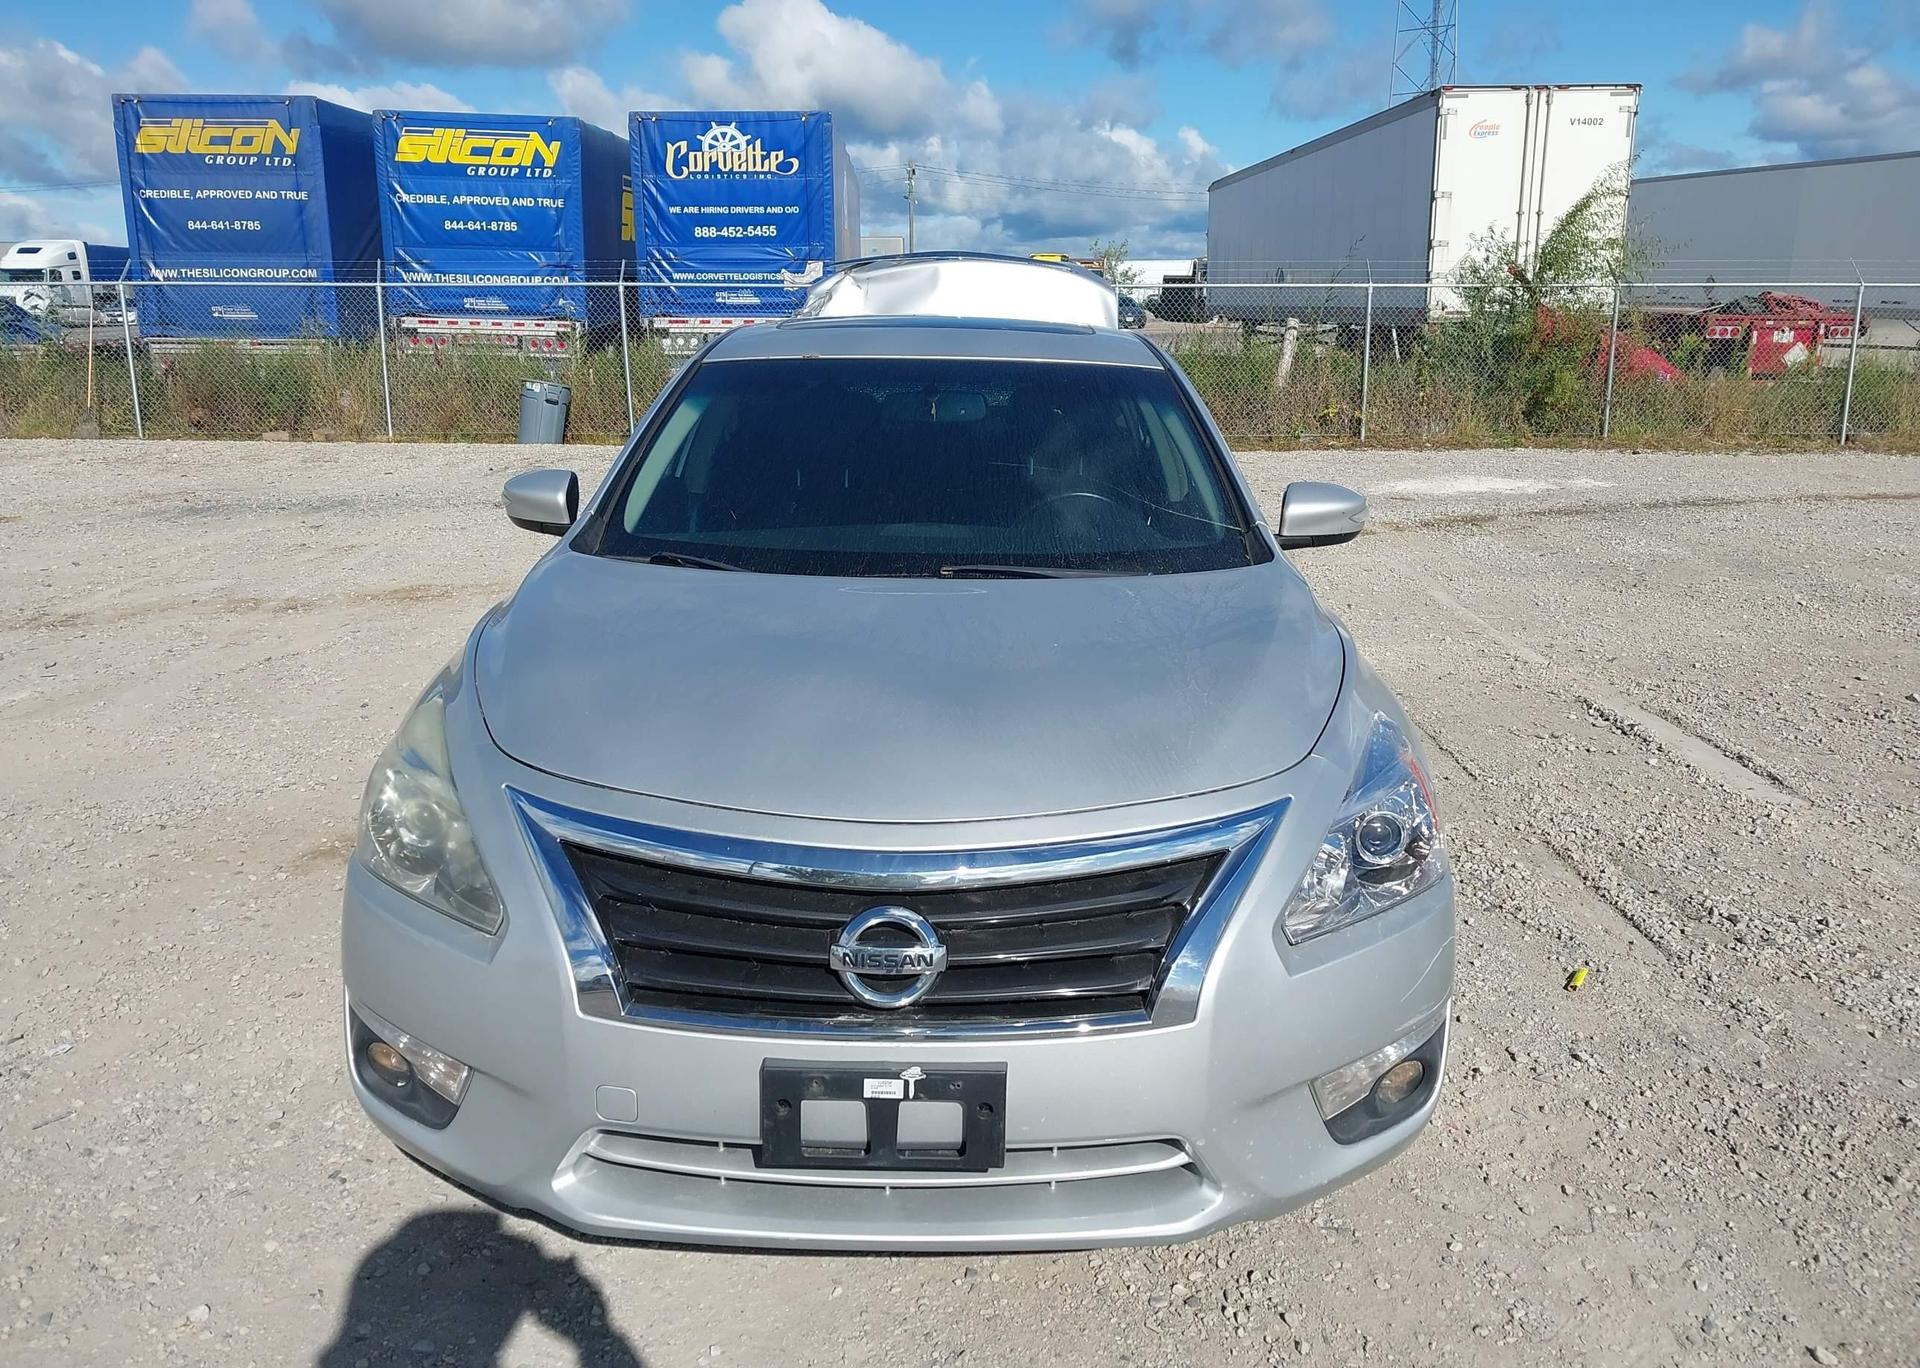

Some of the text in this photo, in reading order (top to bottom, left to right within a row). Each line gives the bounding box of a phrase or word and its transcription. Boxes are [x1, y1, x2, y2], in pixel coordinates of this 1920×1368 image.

[1569, 117, 1604, 126] V14002
[205, 155, 296, 167] GROUP LTD.
[665, 138, 800, 179] Corvette
[467, 166, 557, 178] GROUP LTD.
[139, 189, 309, 200] CREDIBLE, APPROVED AND TRUE
[395, 193, 565, 208] CREDIBLE, APPROVED AND TRUE
[668, 206, 682, 214] WE
[683, 206, 700, 214] ARE
[701, 206, 730, 214] HIRING
[730, 206, 765, 214] DRIVERS
[766, 206, 784, 214] AND
[187, 220, 261, 231] 844-641-8785
[444, 220, 518, 232] 844-641-8785
[694, 225, 777, 238] 888-452-5455
[149, 267, 318, 279] WWW.THESILICONGROUP.COM
[403, 271, 569, 284] WWW.THESILICONGROUPCOM
[672, 272, 801, 281] WWW.CORVETTELOGISTICS.
[842, 952, 934, 969] NISSAN
